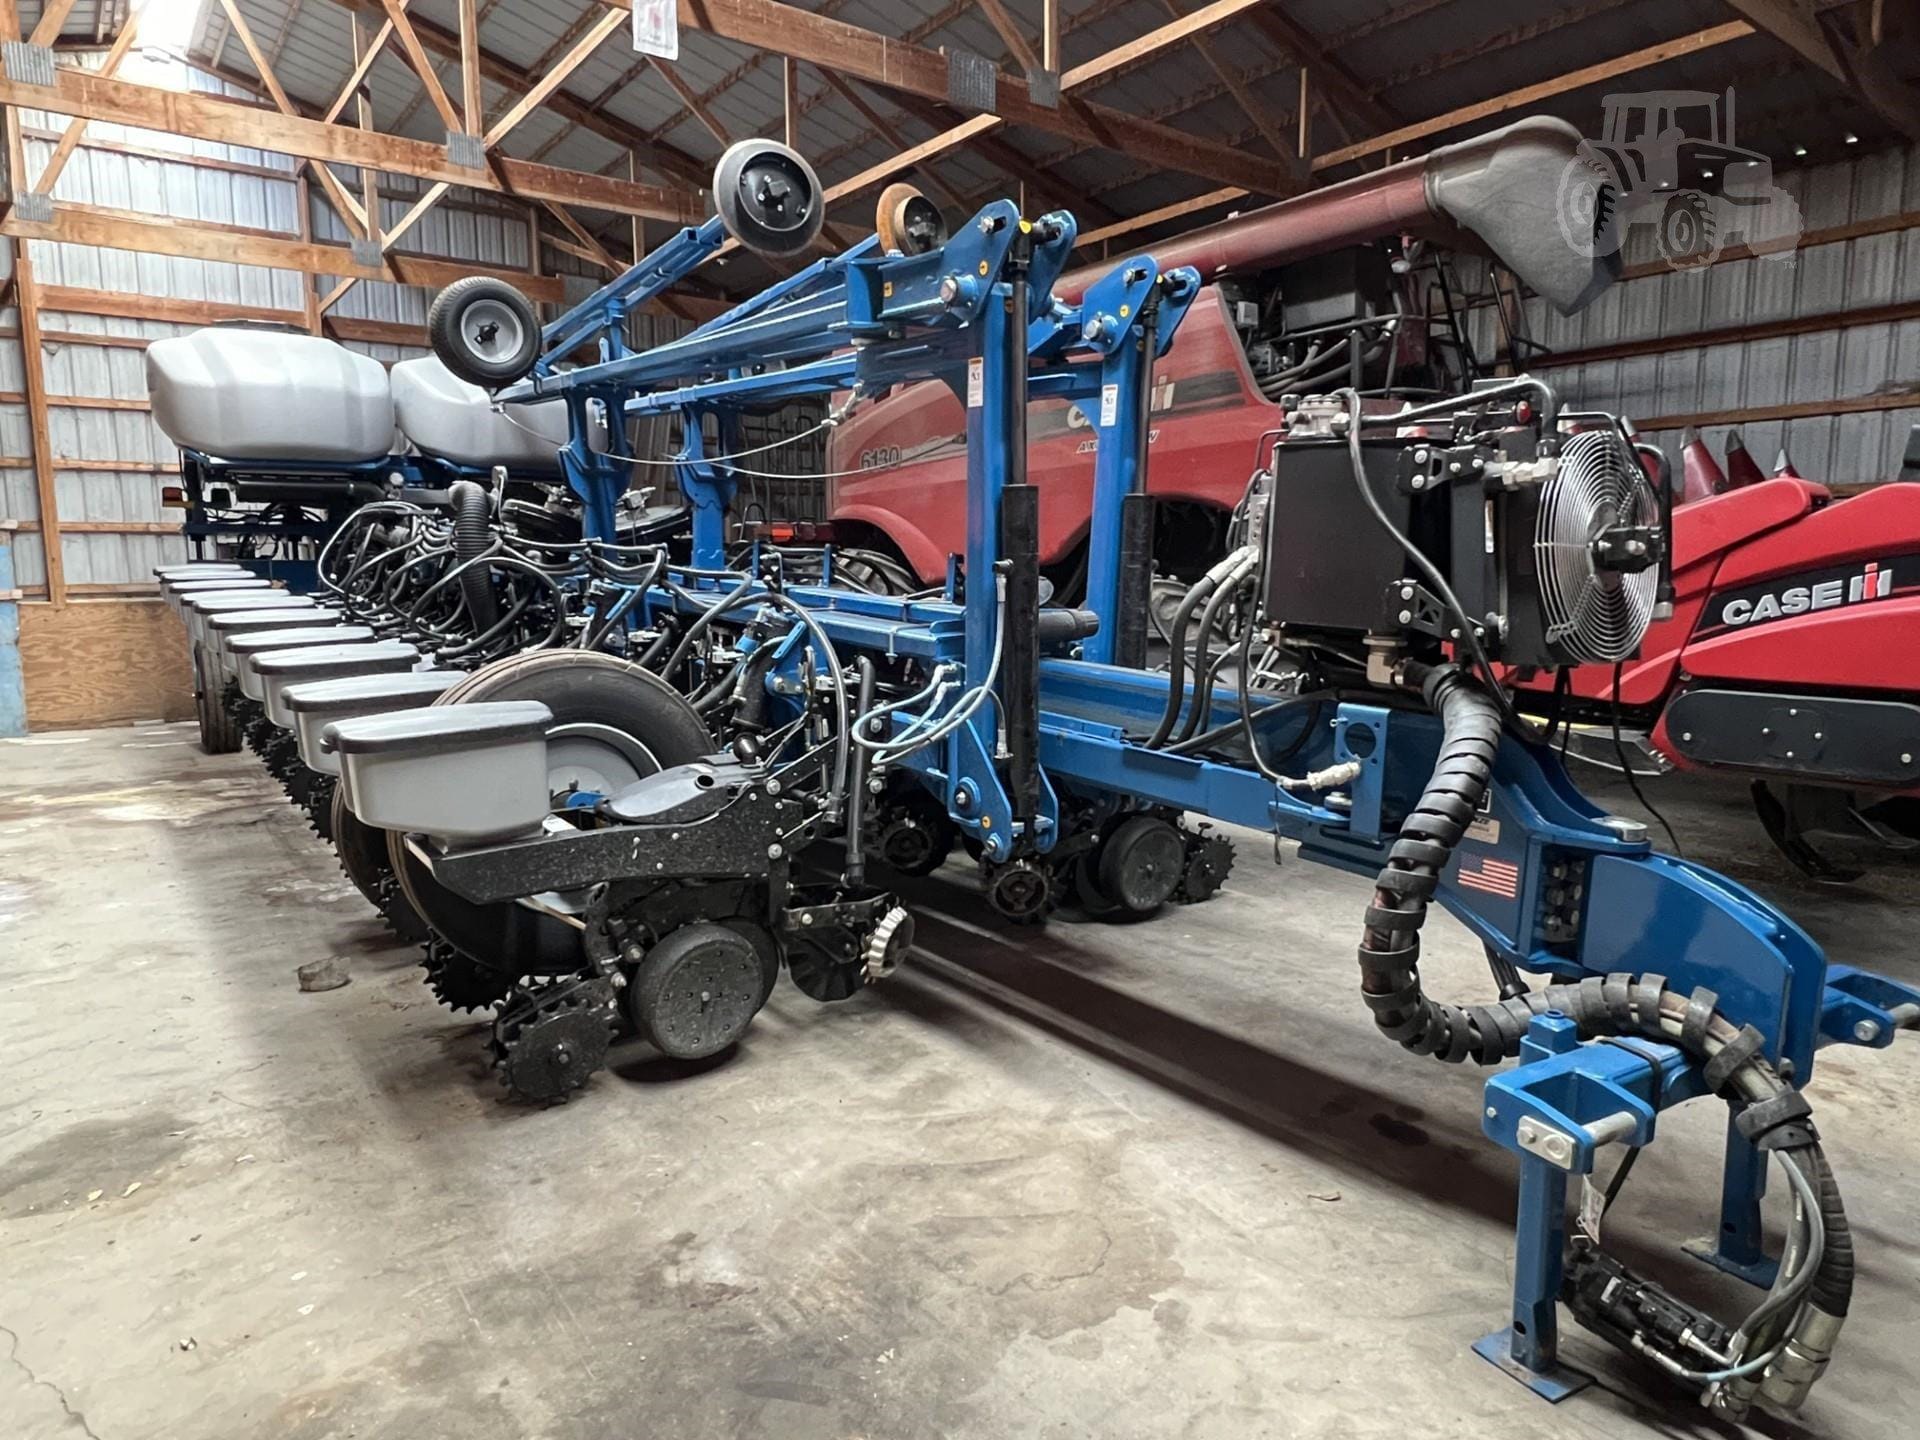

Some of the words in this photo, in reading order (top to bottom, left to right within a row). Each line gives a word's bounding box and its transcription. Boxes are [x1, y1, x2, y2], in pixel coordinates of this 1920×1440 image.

[860, 445, 900, 472] 6130
[1722, 580, 1843, 625] CASE
[1849, 562, 1892, 602] IH
